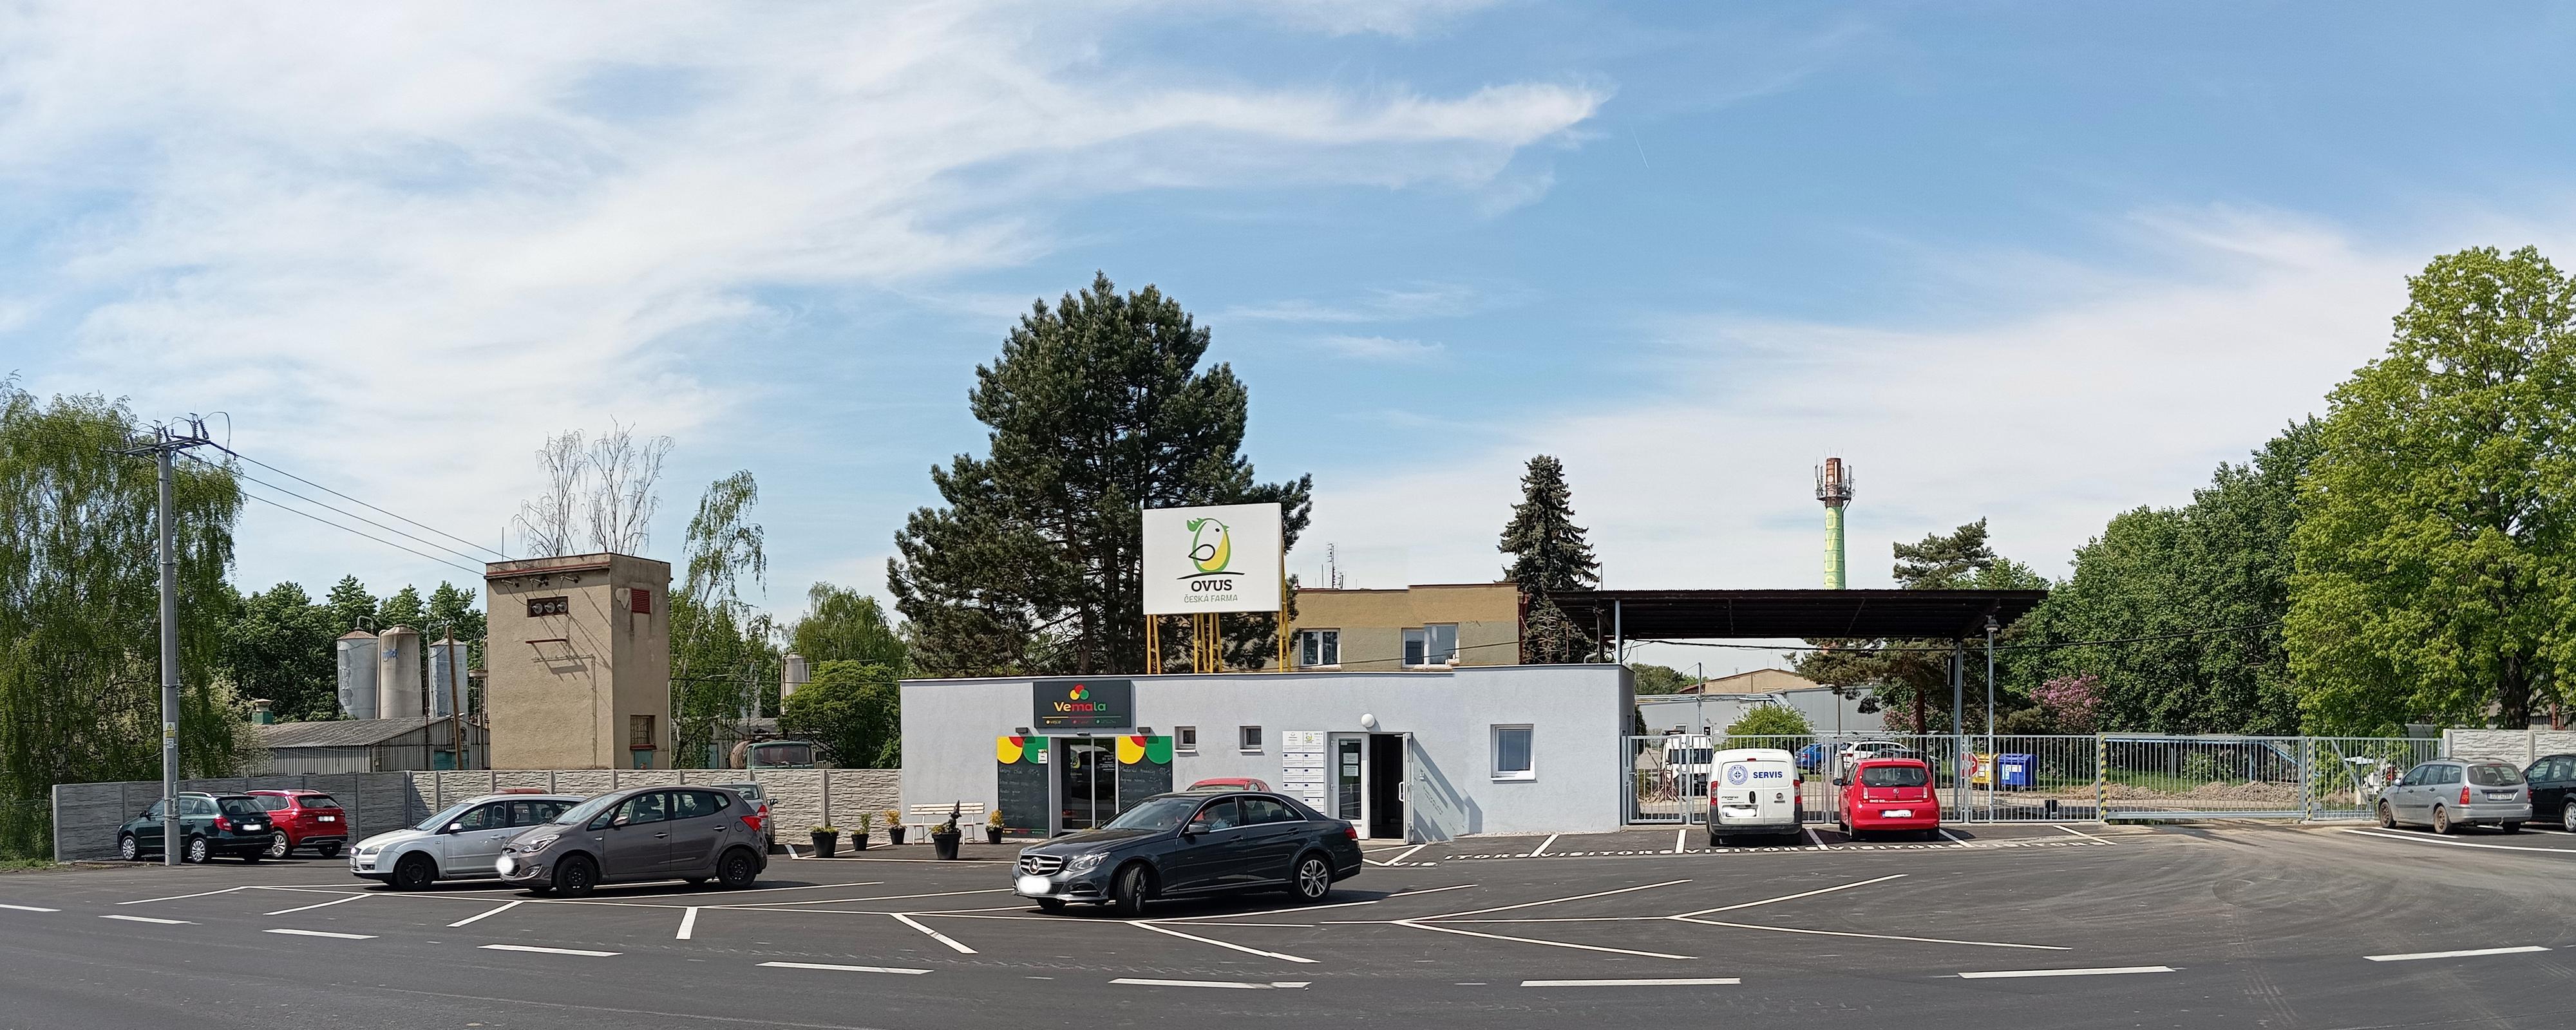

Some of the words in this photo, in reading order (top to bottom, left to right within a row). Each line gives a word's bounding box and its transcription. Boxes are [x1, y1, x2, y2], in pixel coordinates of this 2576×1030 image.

[1824, 510, 1837, 590] OVUS
[1191, 579, 1233, 592] OVUS
[1184, 594, 1209, 603] ČESKÁ
[1053, 701, 1106, 712] Vemala
[1540, 849, 1674, 857] VISITORS
